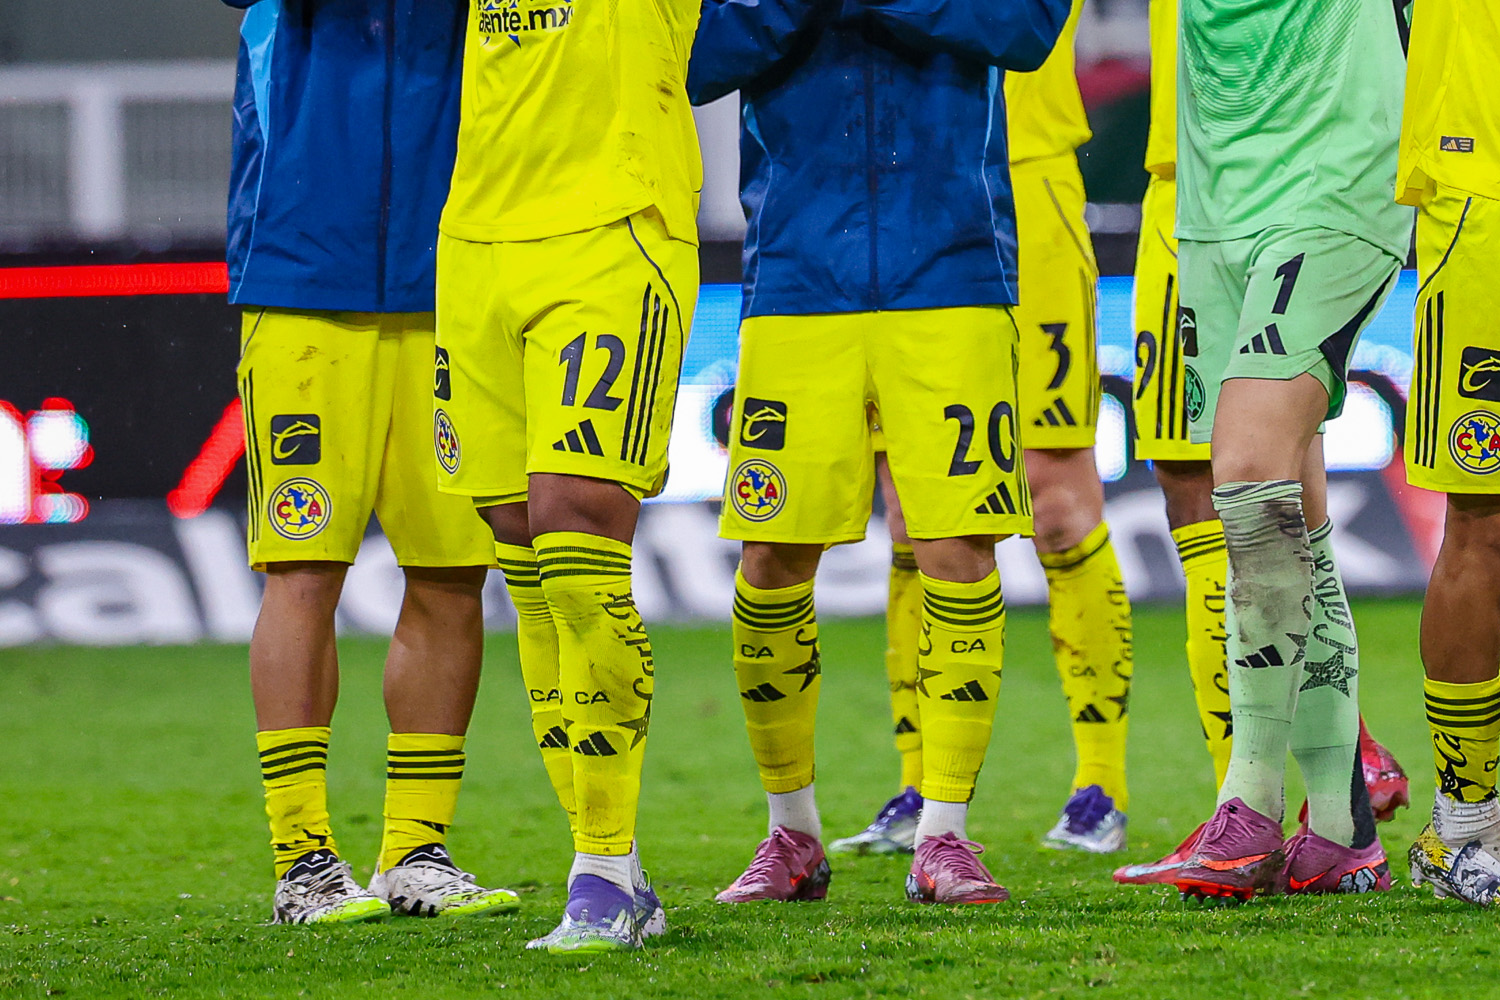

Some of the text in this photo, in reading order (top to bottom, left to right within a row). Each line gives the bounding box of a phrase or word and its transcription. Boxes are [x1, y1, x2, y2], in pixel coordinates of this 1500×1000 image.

[1271, 251, 1306, 316] 1
[559, 331, 626, 412] 12
[1040, 322, 1071, 391] 3
[943, 400, 1017, 478] 20
[741, 644, 775, 659] CA
[951, 638, 986, 654] CA
[574, 690, 610, 705] CA
